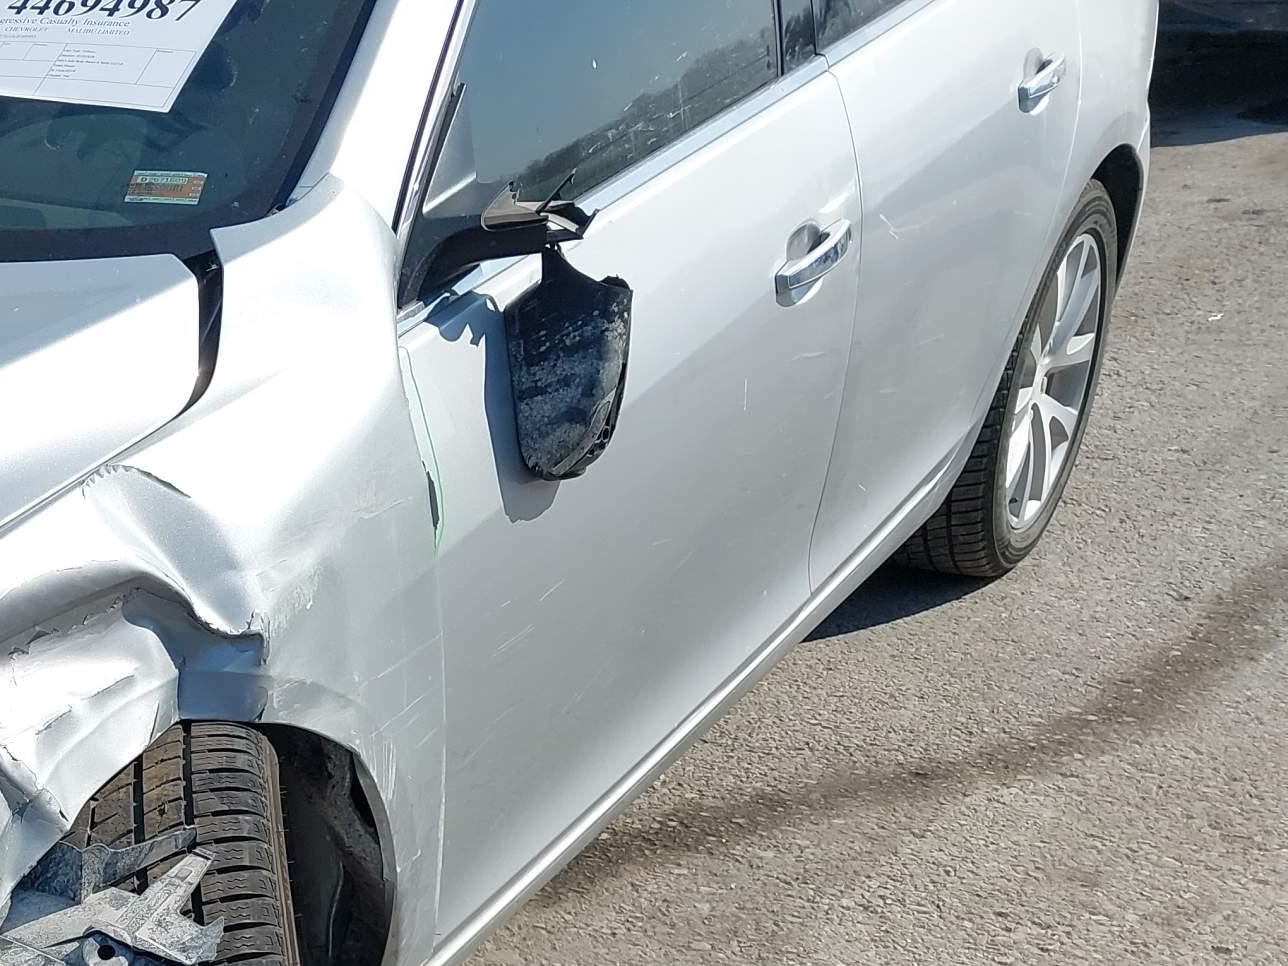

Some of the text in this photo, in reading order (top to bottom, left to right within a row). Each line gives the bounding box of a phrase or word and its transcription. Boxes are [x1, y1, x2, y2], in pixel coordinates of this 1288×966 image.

[7, 0, 200, 21] 44694987
[39, 16, 79, 27] Casualty
[83, 18, 131, 27] Insurance
